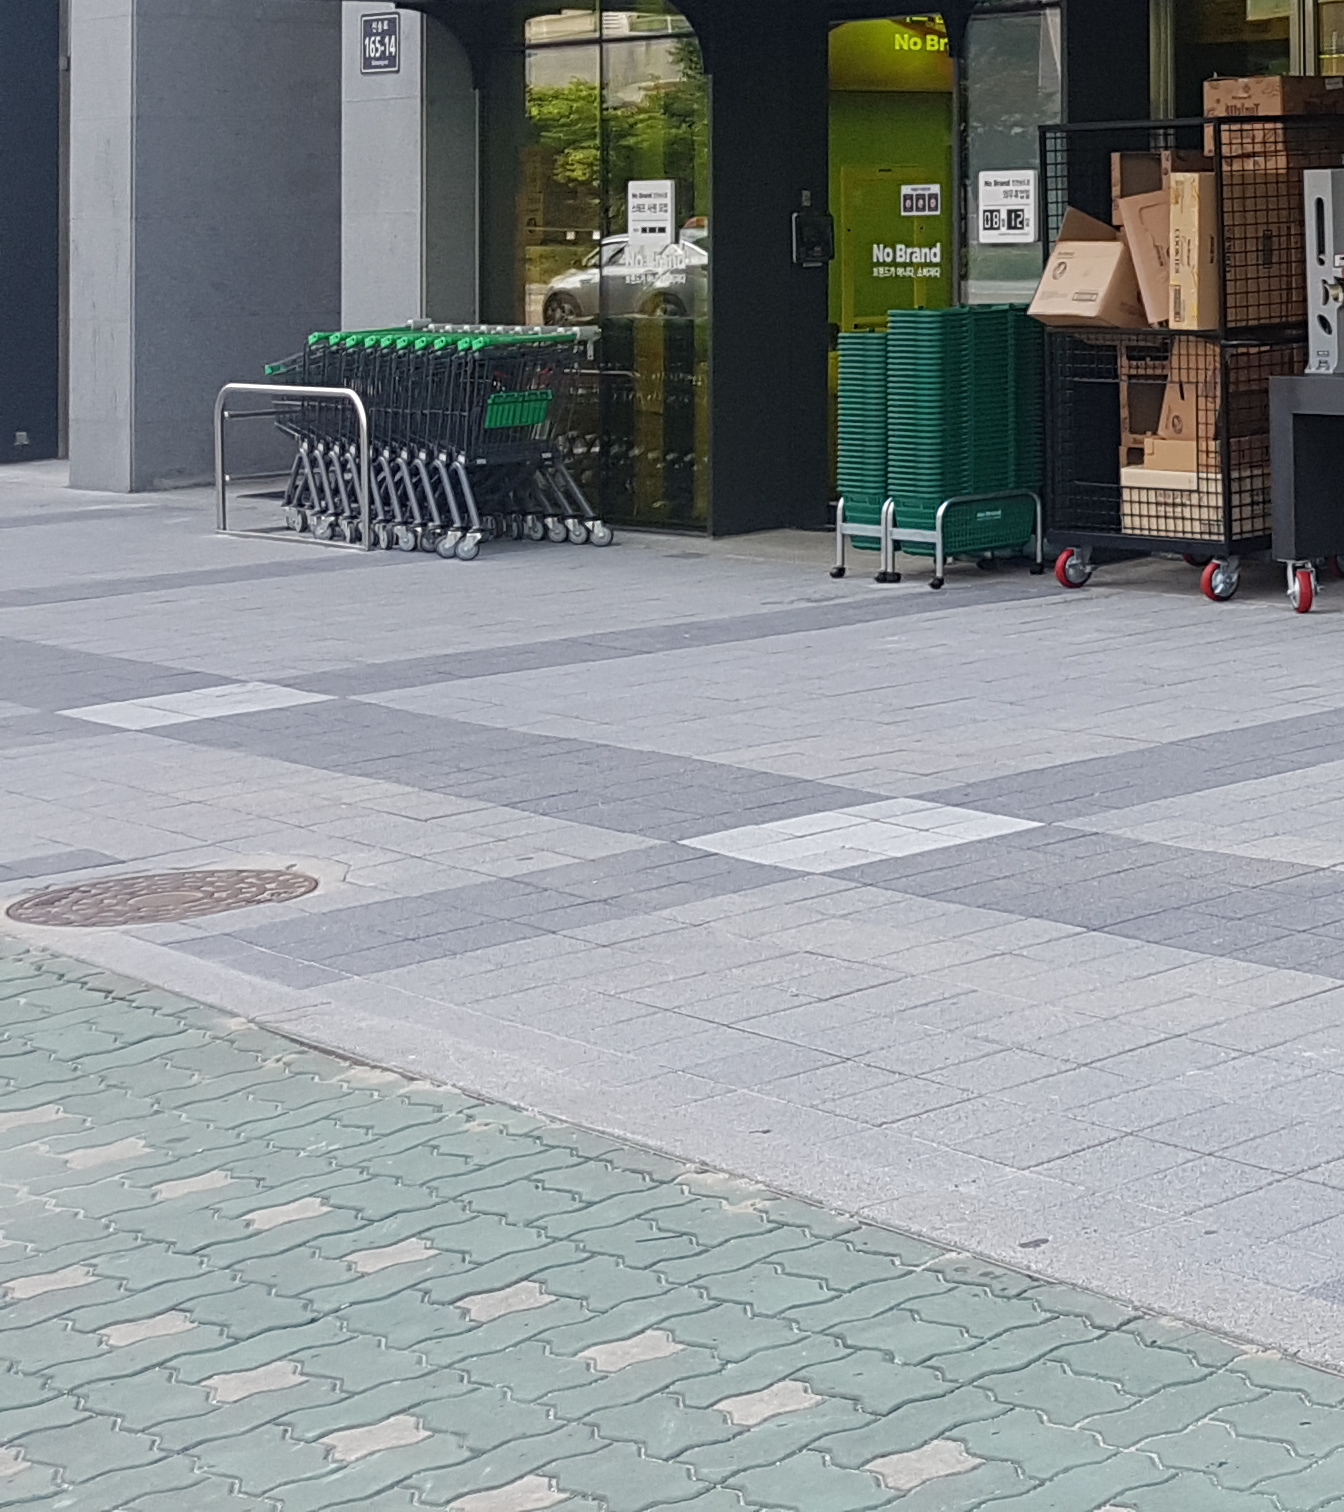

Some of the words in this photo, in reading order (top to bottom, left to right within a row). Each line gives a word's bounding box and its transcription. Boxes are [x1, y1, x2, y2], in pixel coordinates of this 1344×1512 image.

[364, 34, 396, 58] 165-14
[895, 34, 918, 51] No
[925, 34, 949, 51] Br
[984, 211, 1000, 229] 08
[1011, 211, 1024, 228] 12
[872, 243, 894, 263] No
[895, 240, 942, 263] Brand
